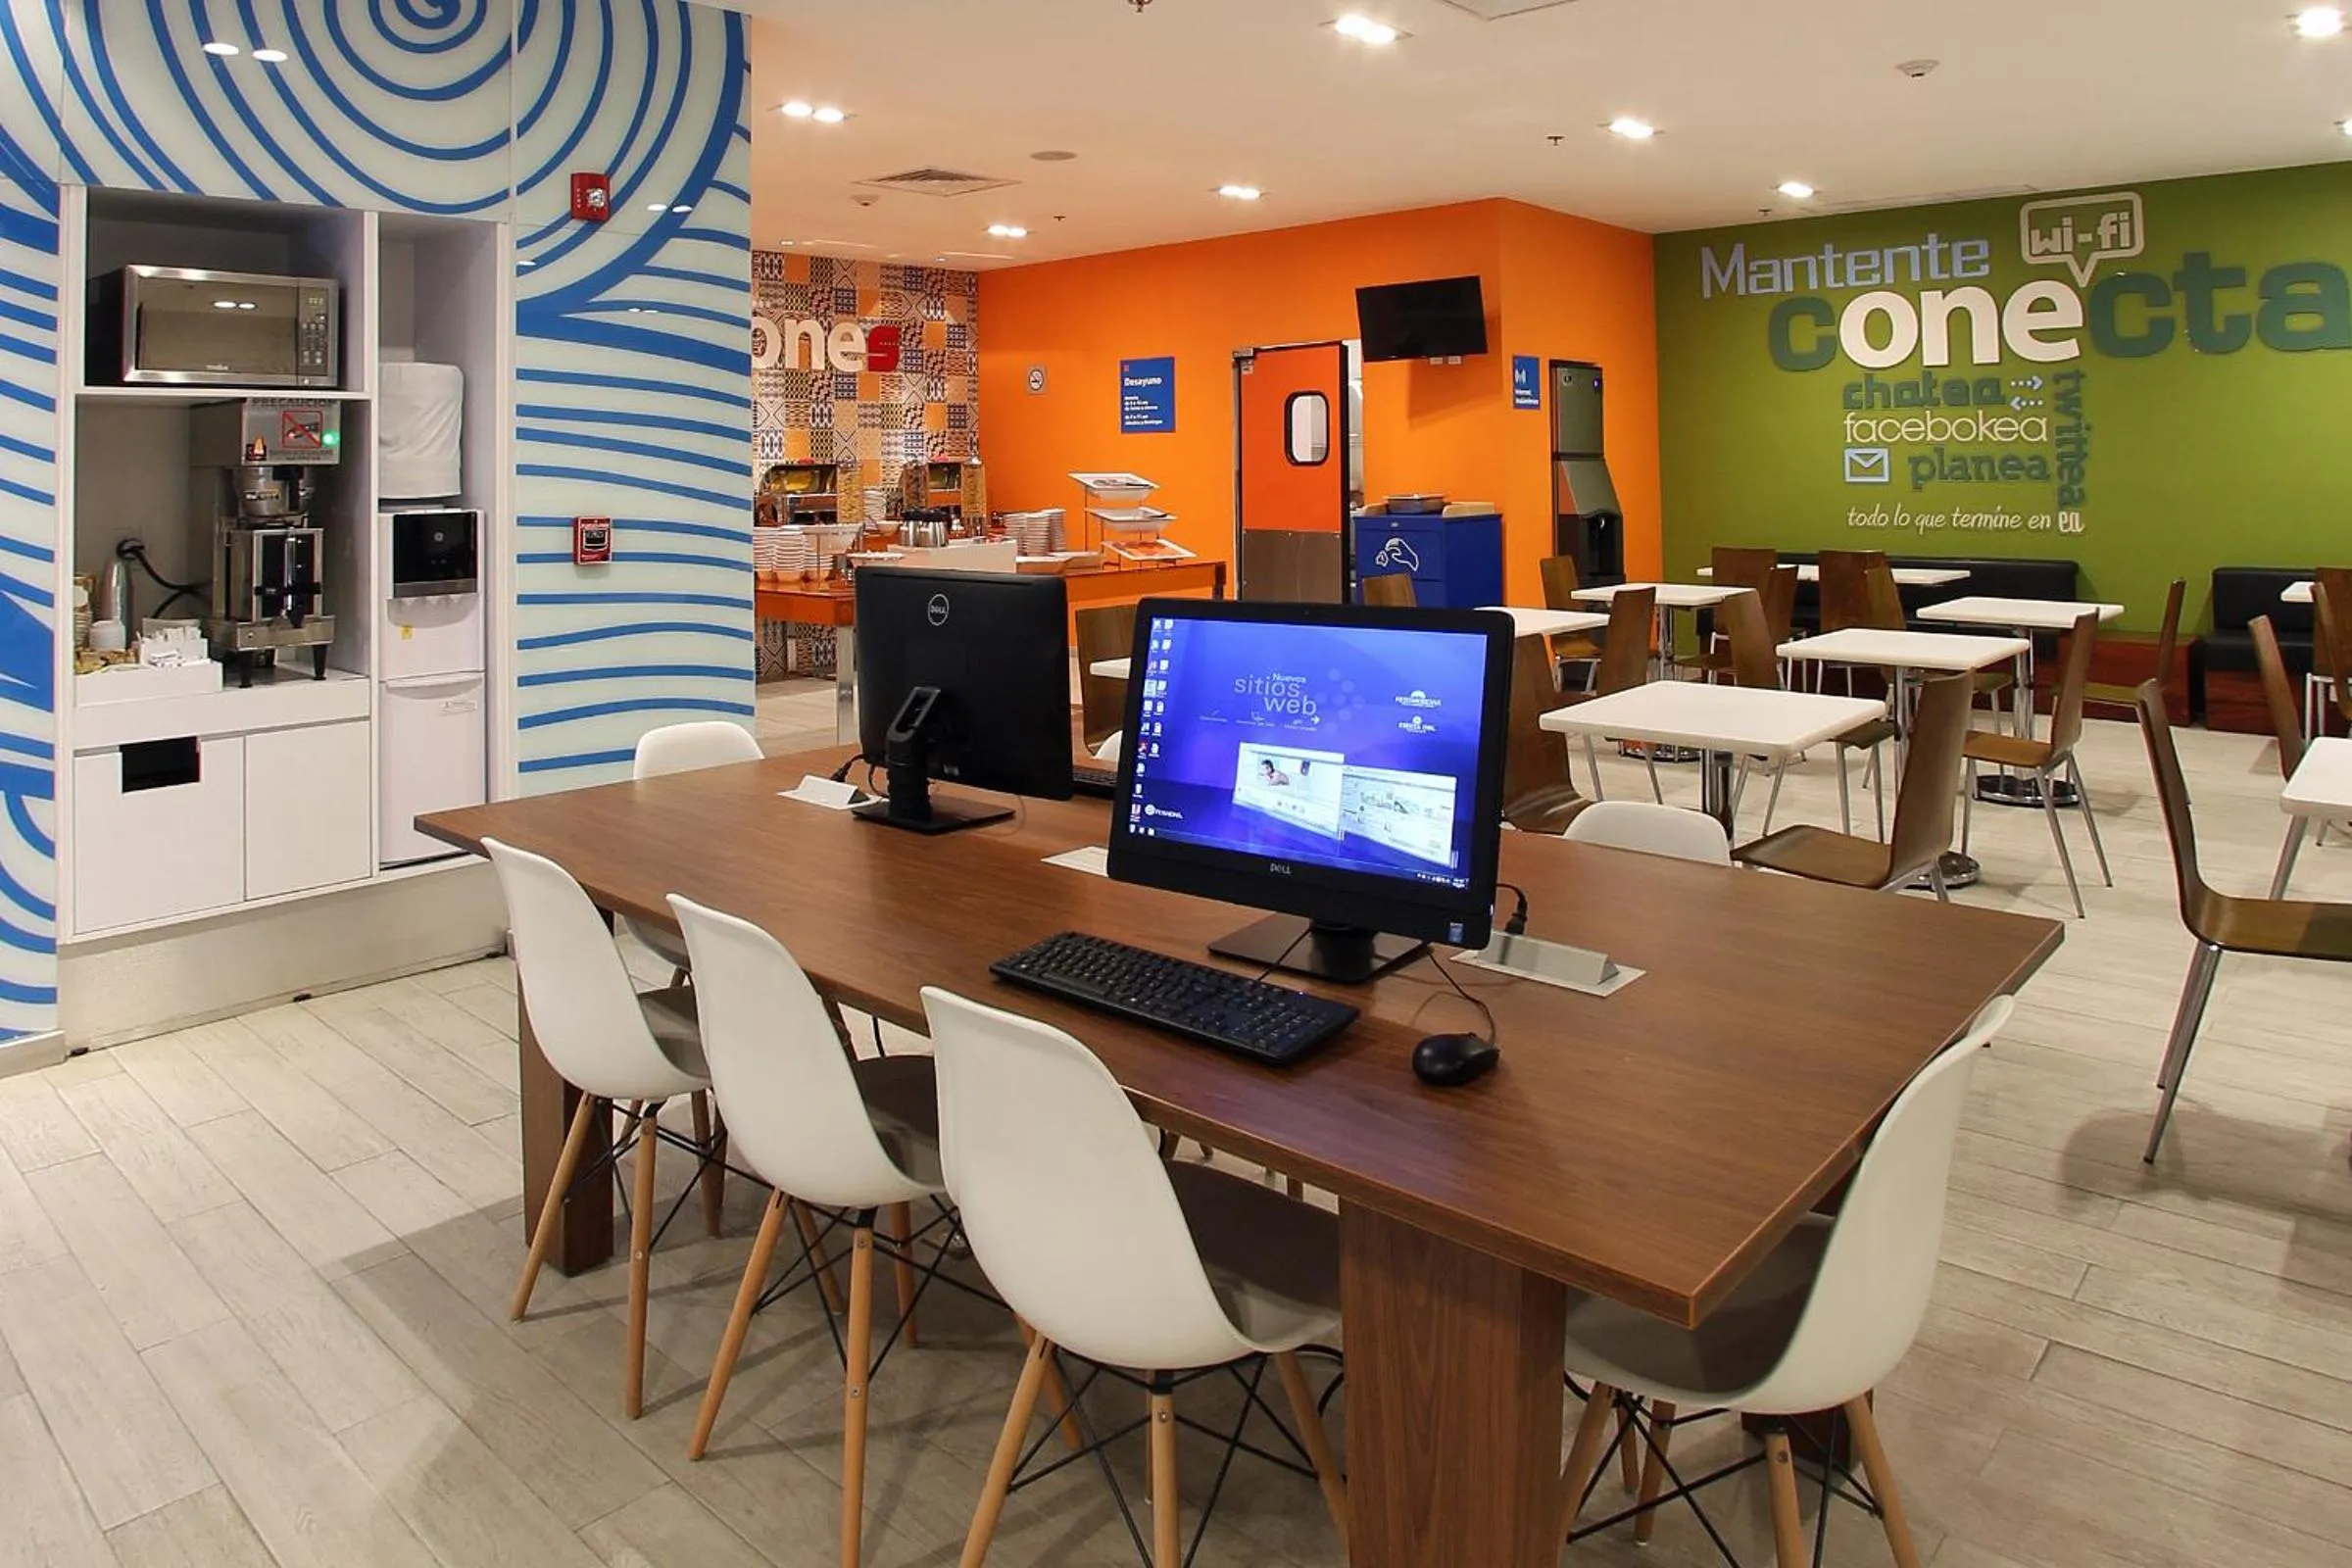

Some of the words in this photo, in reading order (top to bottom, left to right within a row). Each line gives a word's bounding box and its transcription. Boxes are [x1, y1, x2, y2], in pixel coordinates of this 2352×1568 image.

[2030, 211, 2131, 255] wi-fi
[1700, 231, 1990, 299] Mantente
[1768, 251, 2352, 371] conecta
[1123, 376, 1163, 387] Desayuno
[1842, 369, 2007, 410] chatea
[1843, 411, 2048, 443] facebokea
[1907, 446, 2053, 490] planea
[1846, 503, 1889, 527] todo
[1892, 502, 1911, 527] lo
[1914, 511, 1946, 535] que
[1951, 504, 2023, 529] termine
[2027, 512, 2052, 529] en
[1234, 673, 1300, 698] sitios
[1263, 695, 1316, 715] web
[1269, 862, 1293, 876] DELL
